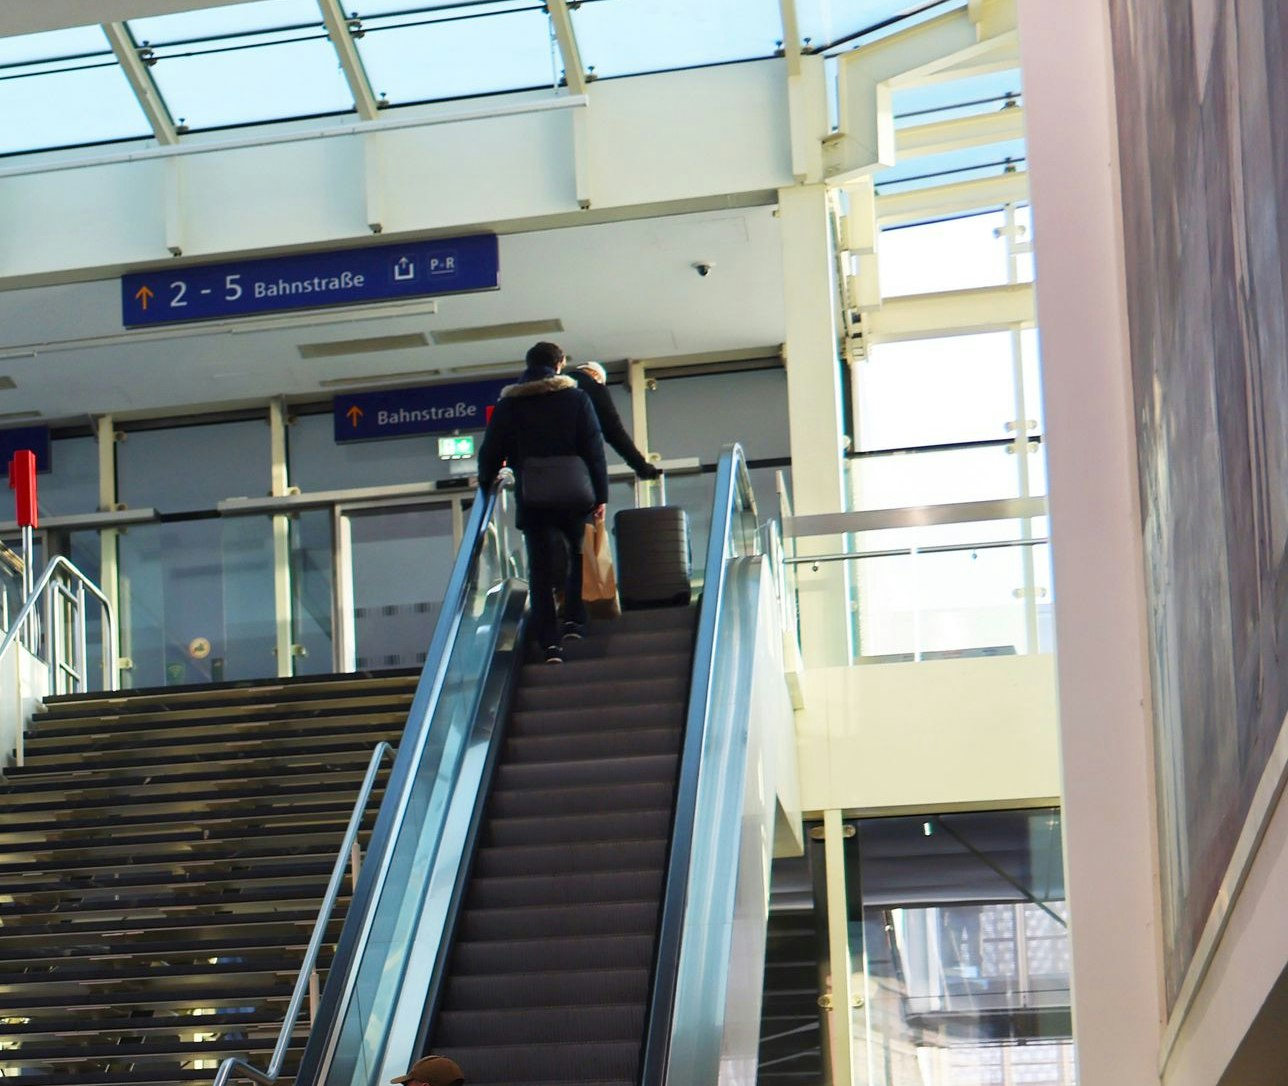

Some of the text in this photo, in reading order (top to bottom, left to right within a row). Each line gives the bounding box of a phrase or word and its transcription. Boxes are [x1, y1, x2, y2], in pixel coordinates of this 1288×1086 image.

[170, 281, 187, 307] 2
[225, 274, 242, 300] 5
[254, 271, 365, 298] Bahnstraße
[377, 401, 477, 425] Bahnstraße
